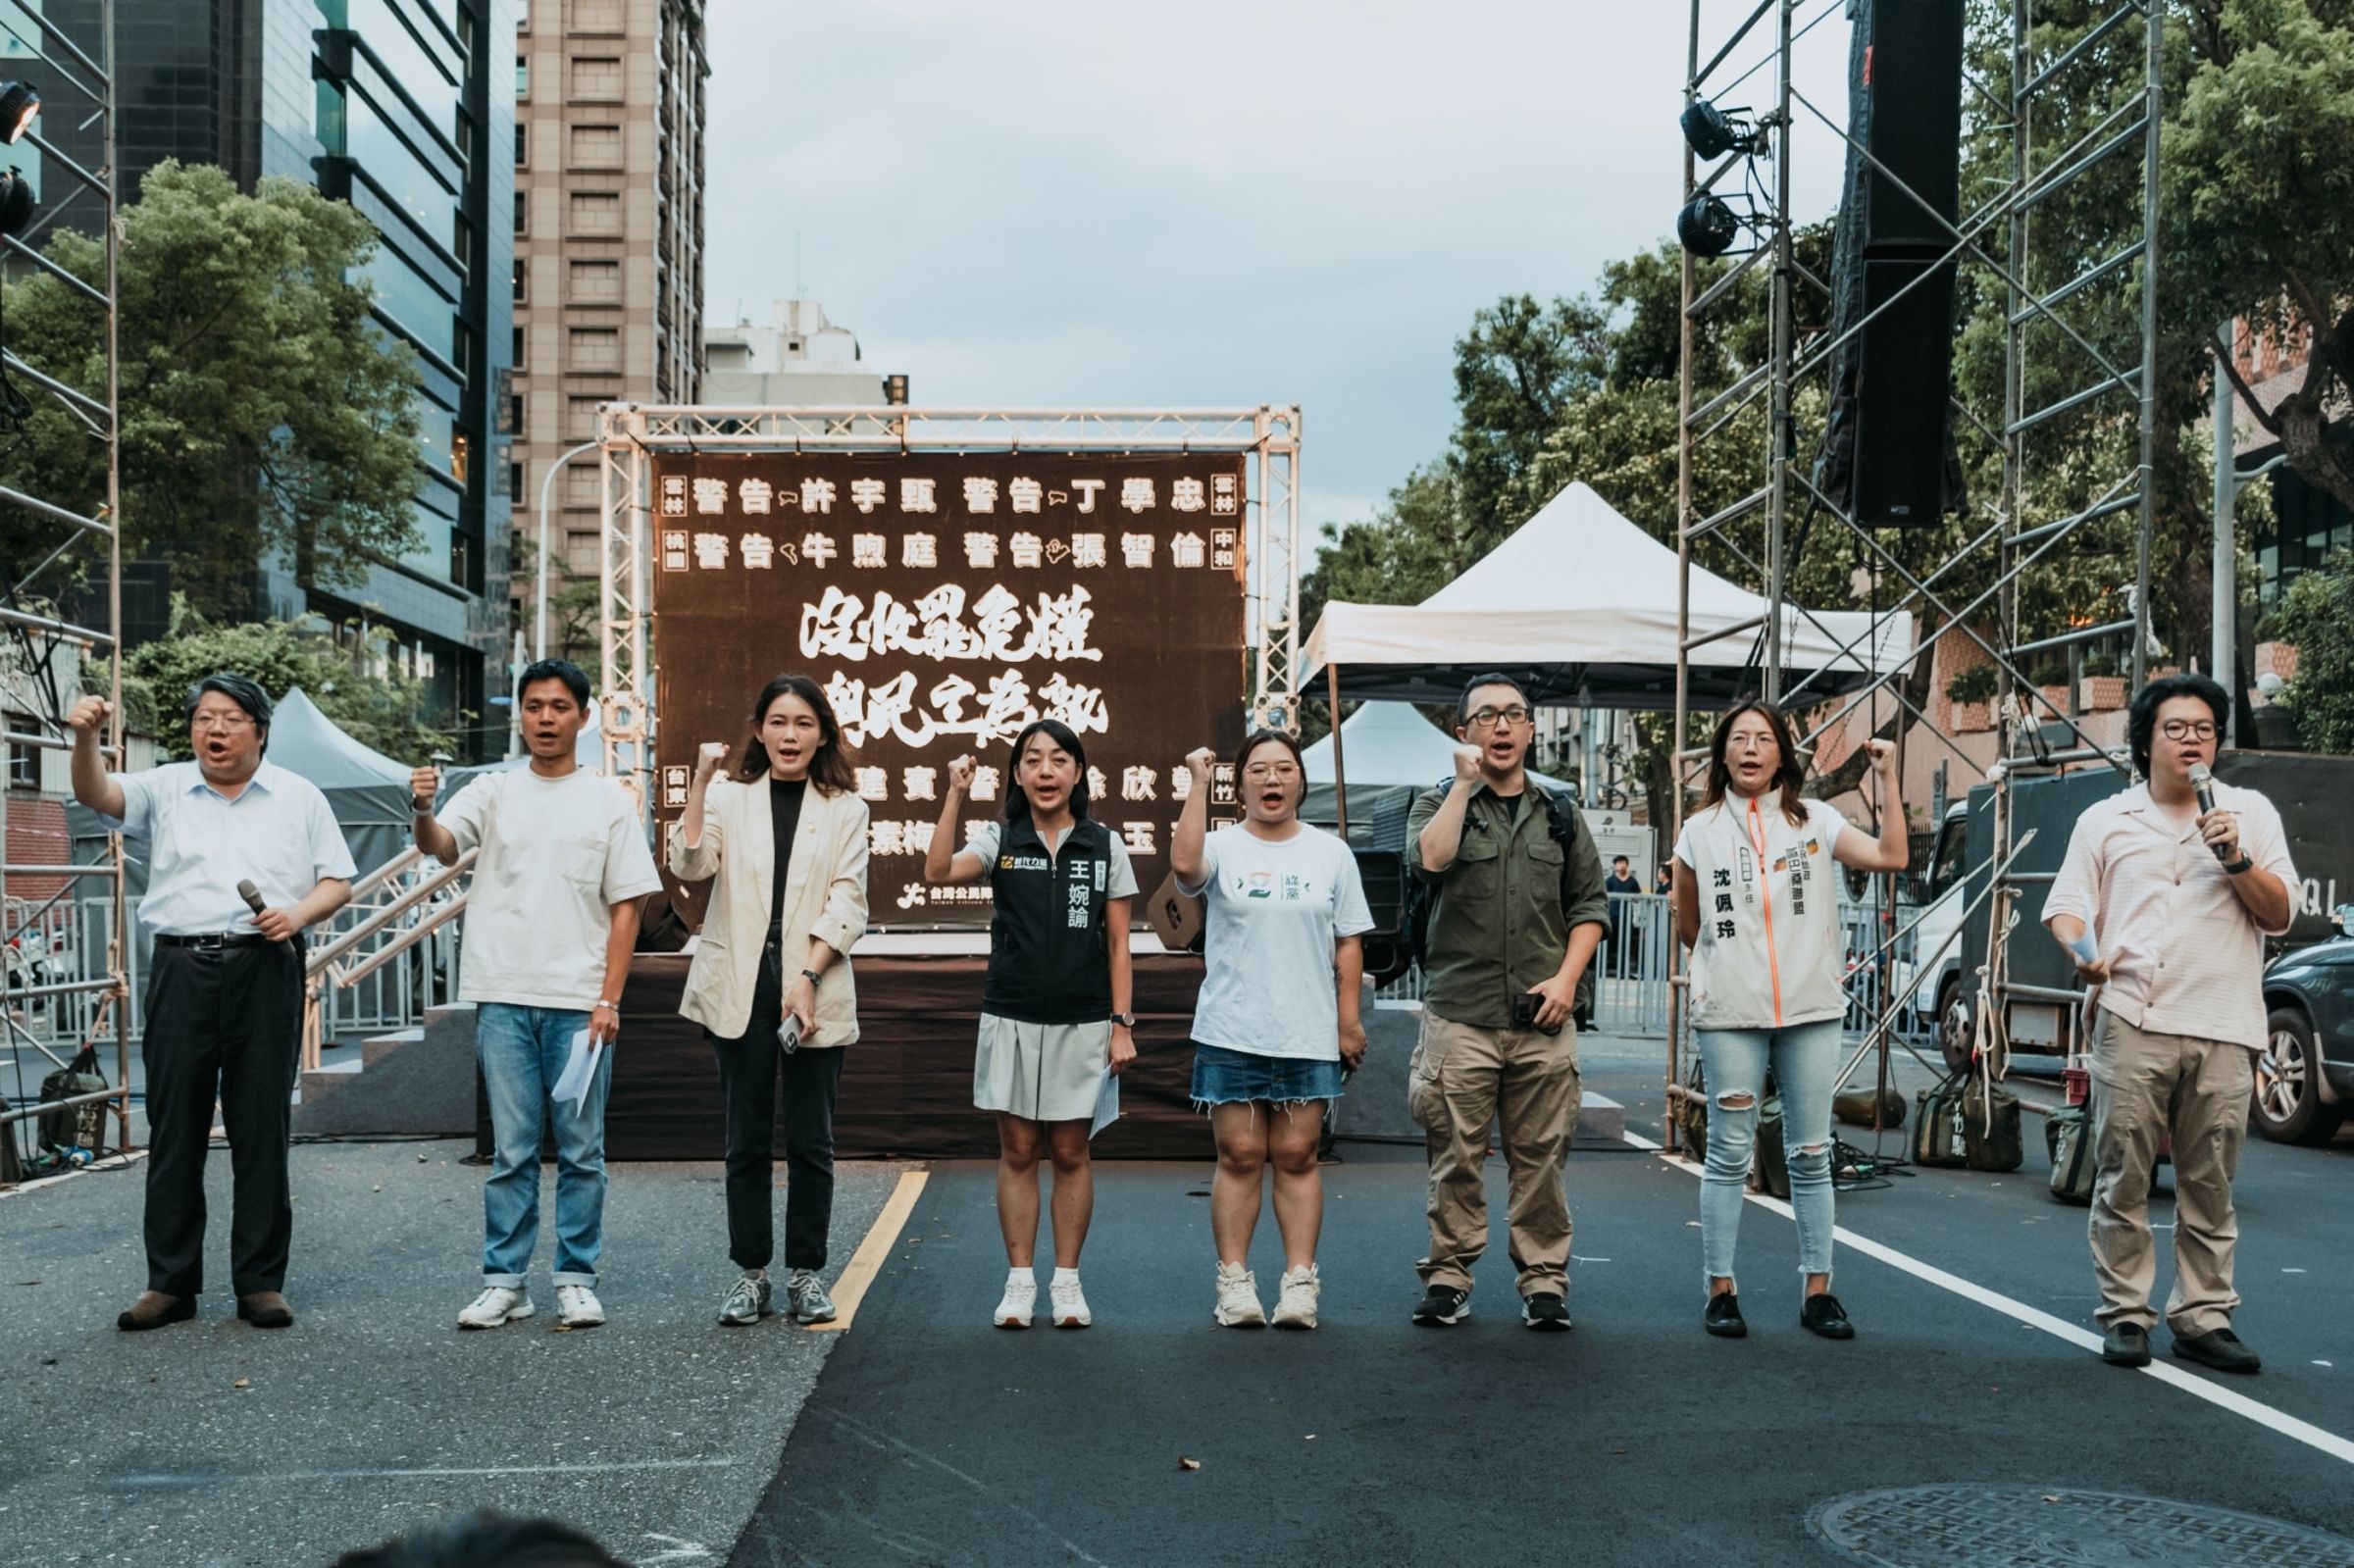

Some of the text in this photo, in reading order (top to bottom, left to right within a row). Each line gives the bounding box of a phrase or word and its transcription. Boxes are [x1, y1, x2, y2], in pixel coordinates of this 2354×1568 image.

[664, 478, 685, 515] 雲林
[1214, 477, 1235, 513] 雲林
[1214, 531, 1235, 568] 中和
[798, 582, 1104, 663] 沒收罷免權
[667, 769, 687, 804] 台東
[1214, 766, 1235, 801] 新竹
[1068, 859, 1091, 929] 王婉諭
[1714, 868, 1736, 939] 沈佩玲
